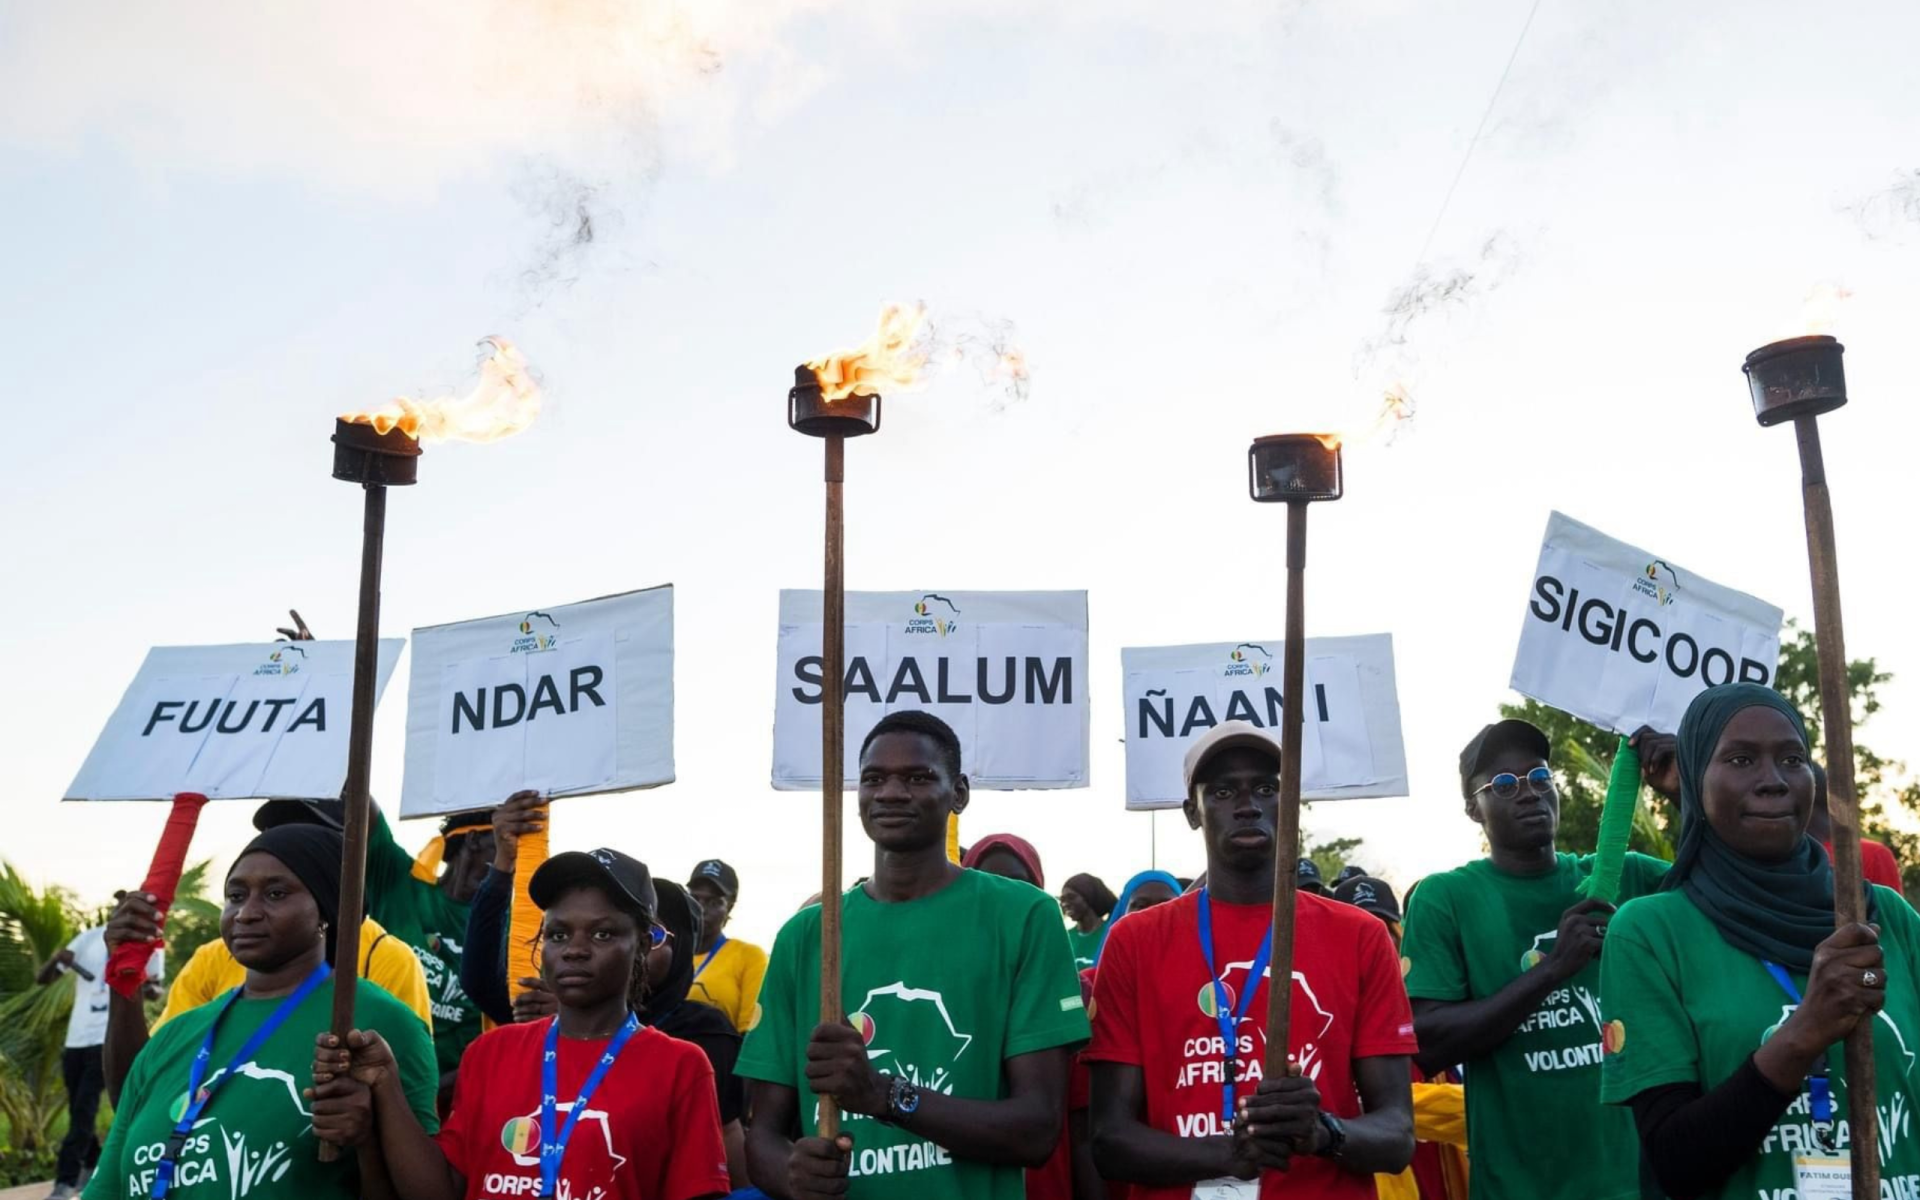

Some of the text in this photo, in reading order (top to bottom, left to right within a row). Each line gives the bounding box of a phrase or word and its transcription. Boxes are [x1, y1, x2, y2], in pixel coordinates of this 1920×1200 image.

[1632, 583, 1658, 600] AFRICA
[905, 626, 937, 634] AFRICA
[511, 643, 538, 653] AFRICA
[792, 655, 1072, 705] SAALUM
[1224, 668, 1253, 676] AFRICA
[451, 665, 606, 734] NDAR
[142, 697, 327, 737] FUUTA
[1524, 1042, 1603, 1072] VOLONT
[134, 1134, 210, 1165] COPS
[848, 1141, 953, 1177] LONTAIRE
[129, 1158, 217, 1197] AFICA
[483, 1173, 543, 1197] ORPS
